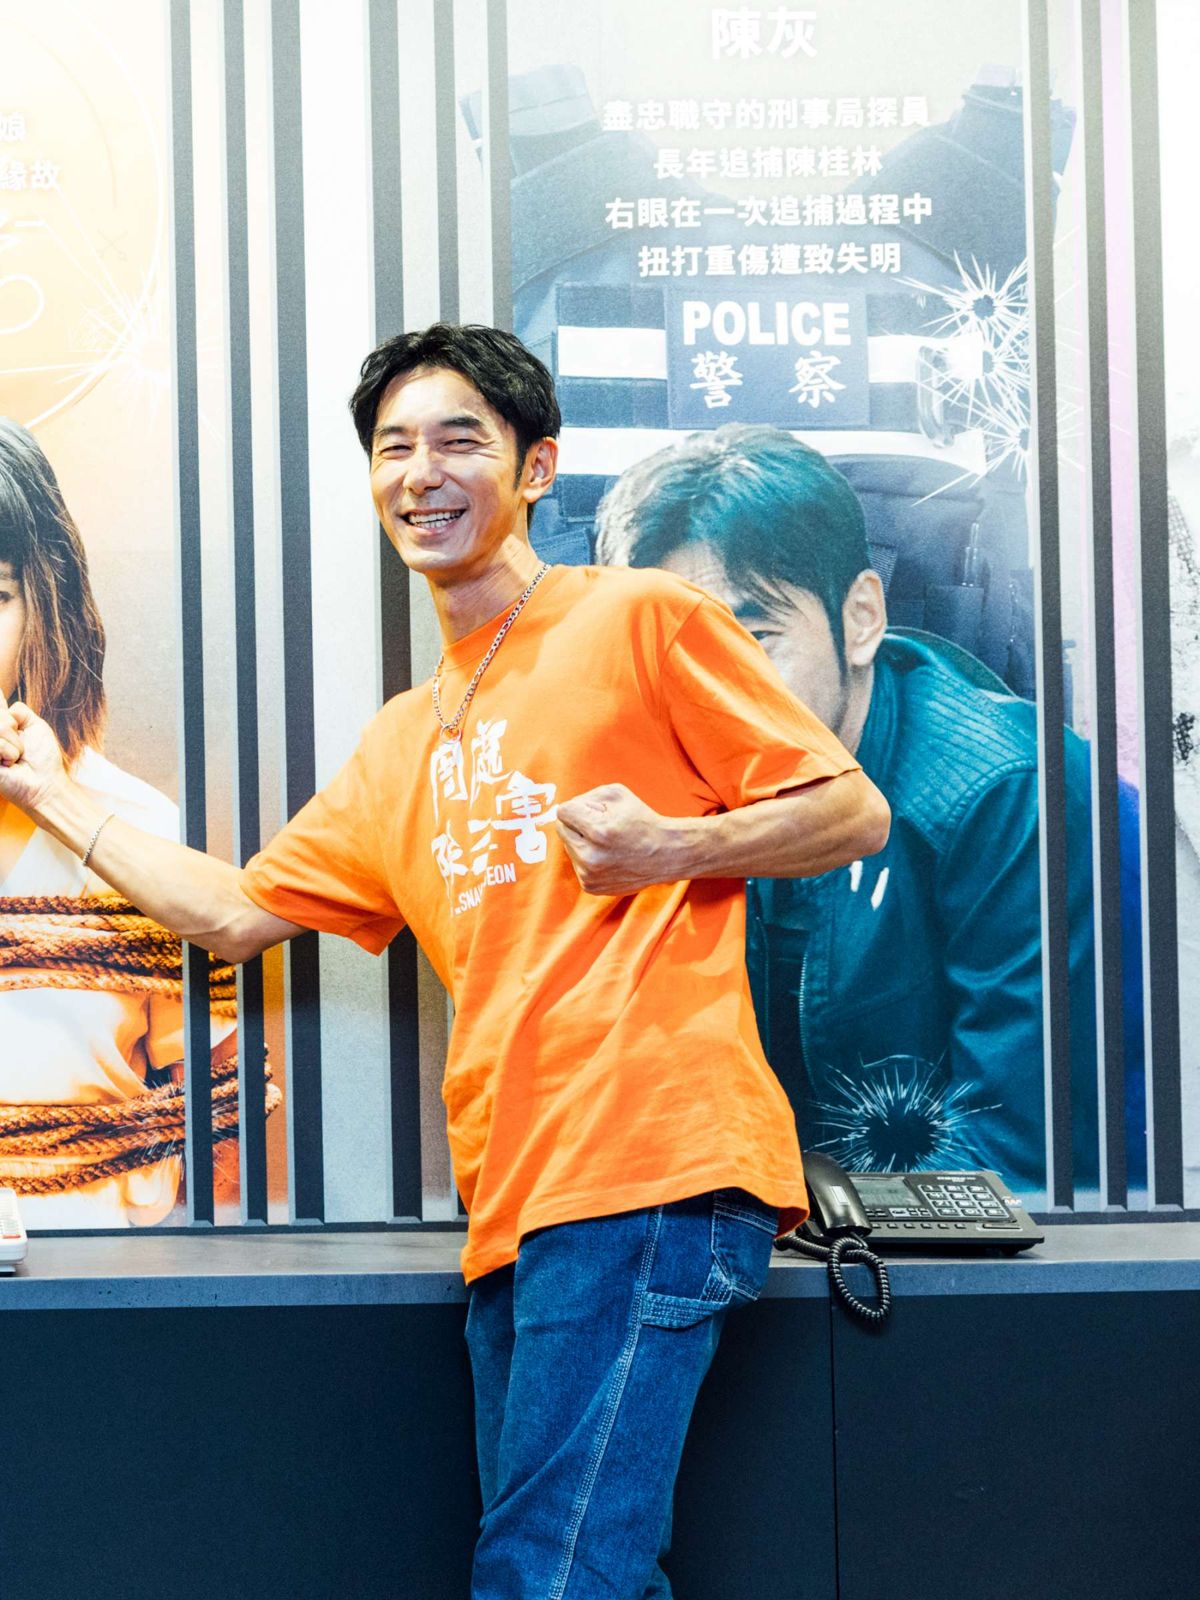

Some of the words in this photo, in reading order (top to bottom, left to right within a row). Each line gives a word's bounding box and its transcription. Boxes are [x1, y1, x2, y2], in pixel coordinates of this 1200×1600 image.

[711, 7, 818, 60] 陳灰
[602, 96, 931, 131] 盡忠職守的刑事局探員
[654, 146, 884, 180] 長年追捕陳桂林
[605, 194, 932, 230] 右眼在一次追捕過程中
[638, 243, 901, 277] 扭打重傷遭致失明
[683, 300, 851, 347] POLICE
